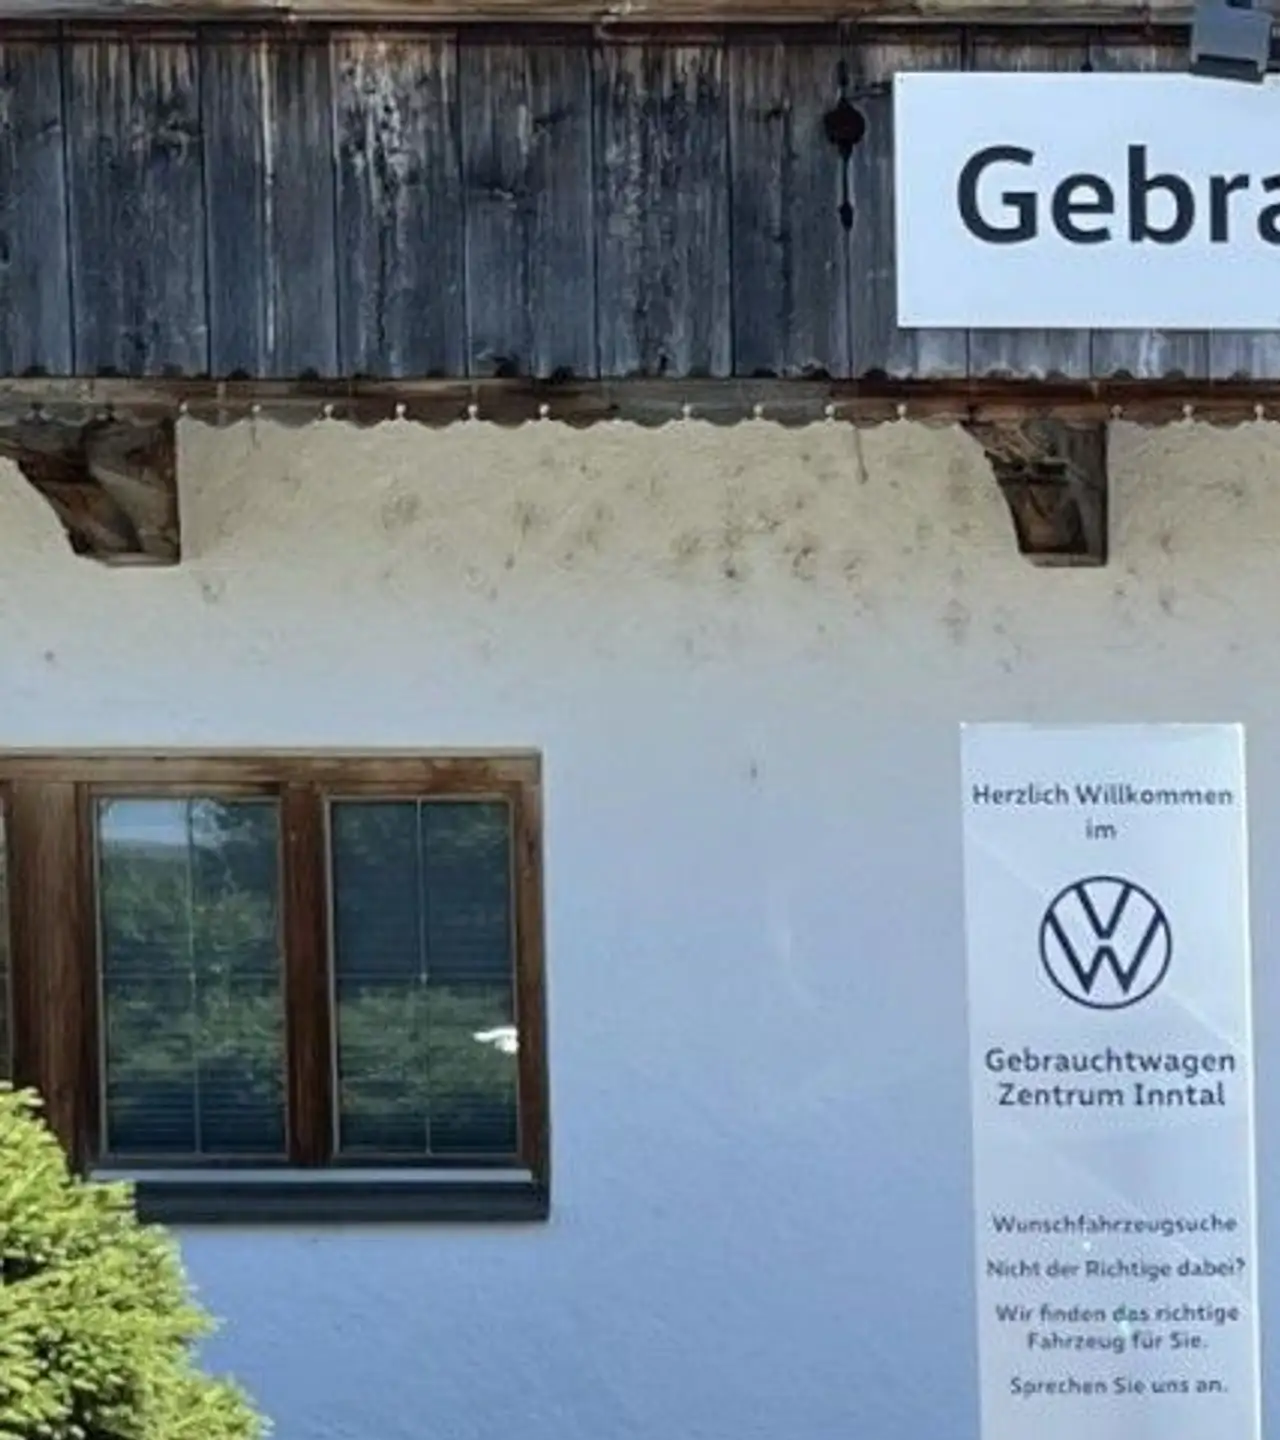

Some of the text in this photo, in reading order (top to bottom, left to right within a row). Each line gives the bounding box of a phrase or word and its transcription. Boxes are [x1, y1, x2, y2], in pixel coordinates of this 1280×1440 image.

[972, 784, 1234, 806] Herzlich Willkommen
[1085, 821, 1118, 840] im
[985, 1047, 1236, 1078] Gebrauchtwagen
[998, 1082, 1226, 1107] Zentrum Inntal
[992, 1214, 1237, 1236] Wunschfahrzeugsuche
[986, 1257, 1245, 1282] Nicht der Richtige dabei?
[995, 1303, 1240, 1326] Wir finden das richtige
[1027, 1330, 1210, 1353] Fahrzeug für Sie.
[1010, 1376, 1108, 1398] Sprechen
[1112, 1376, 1147, 1395] Sie
[1151, 1378, 1190, 1395] uns
